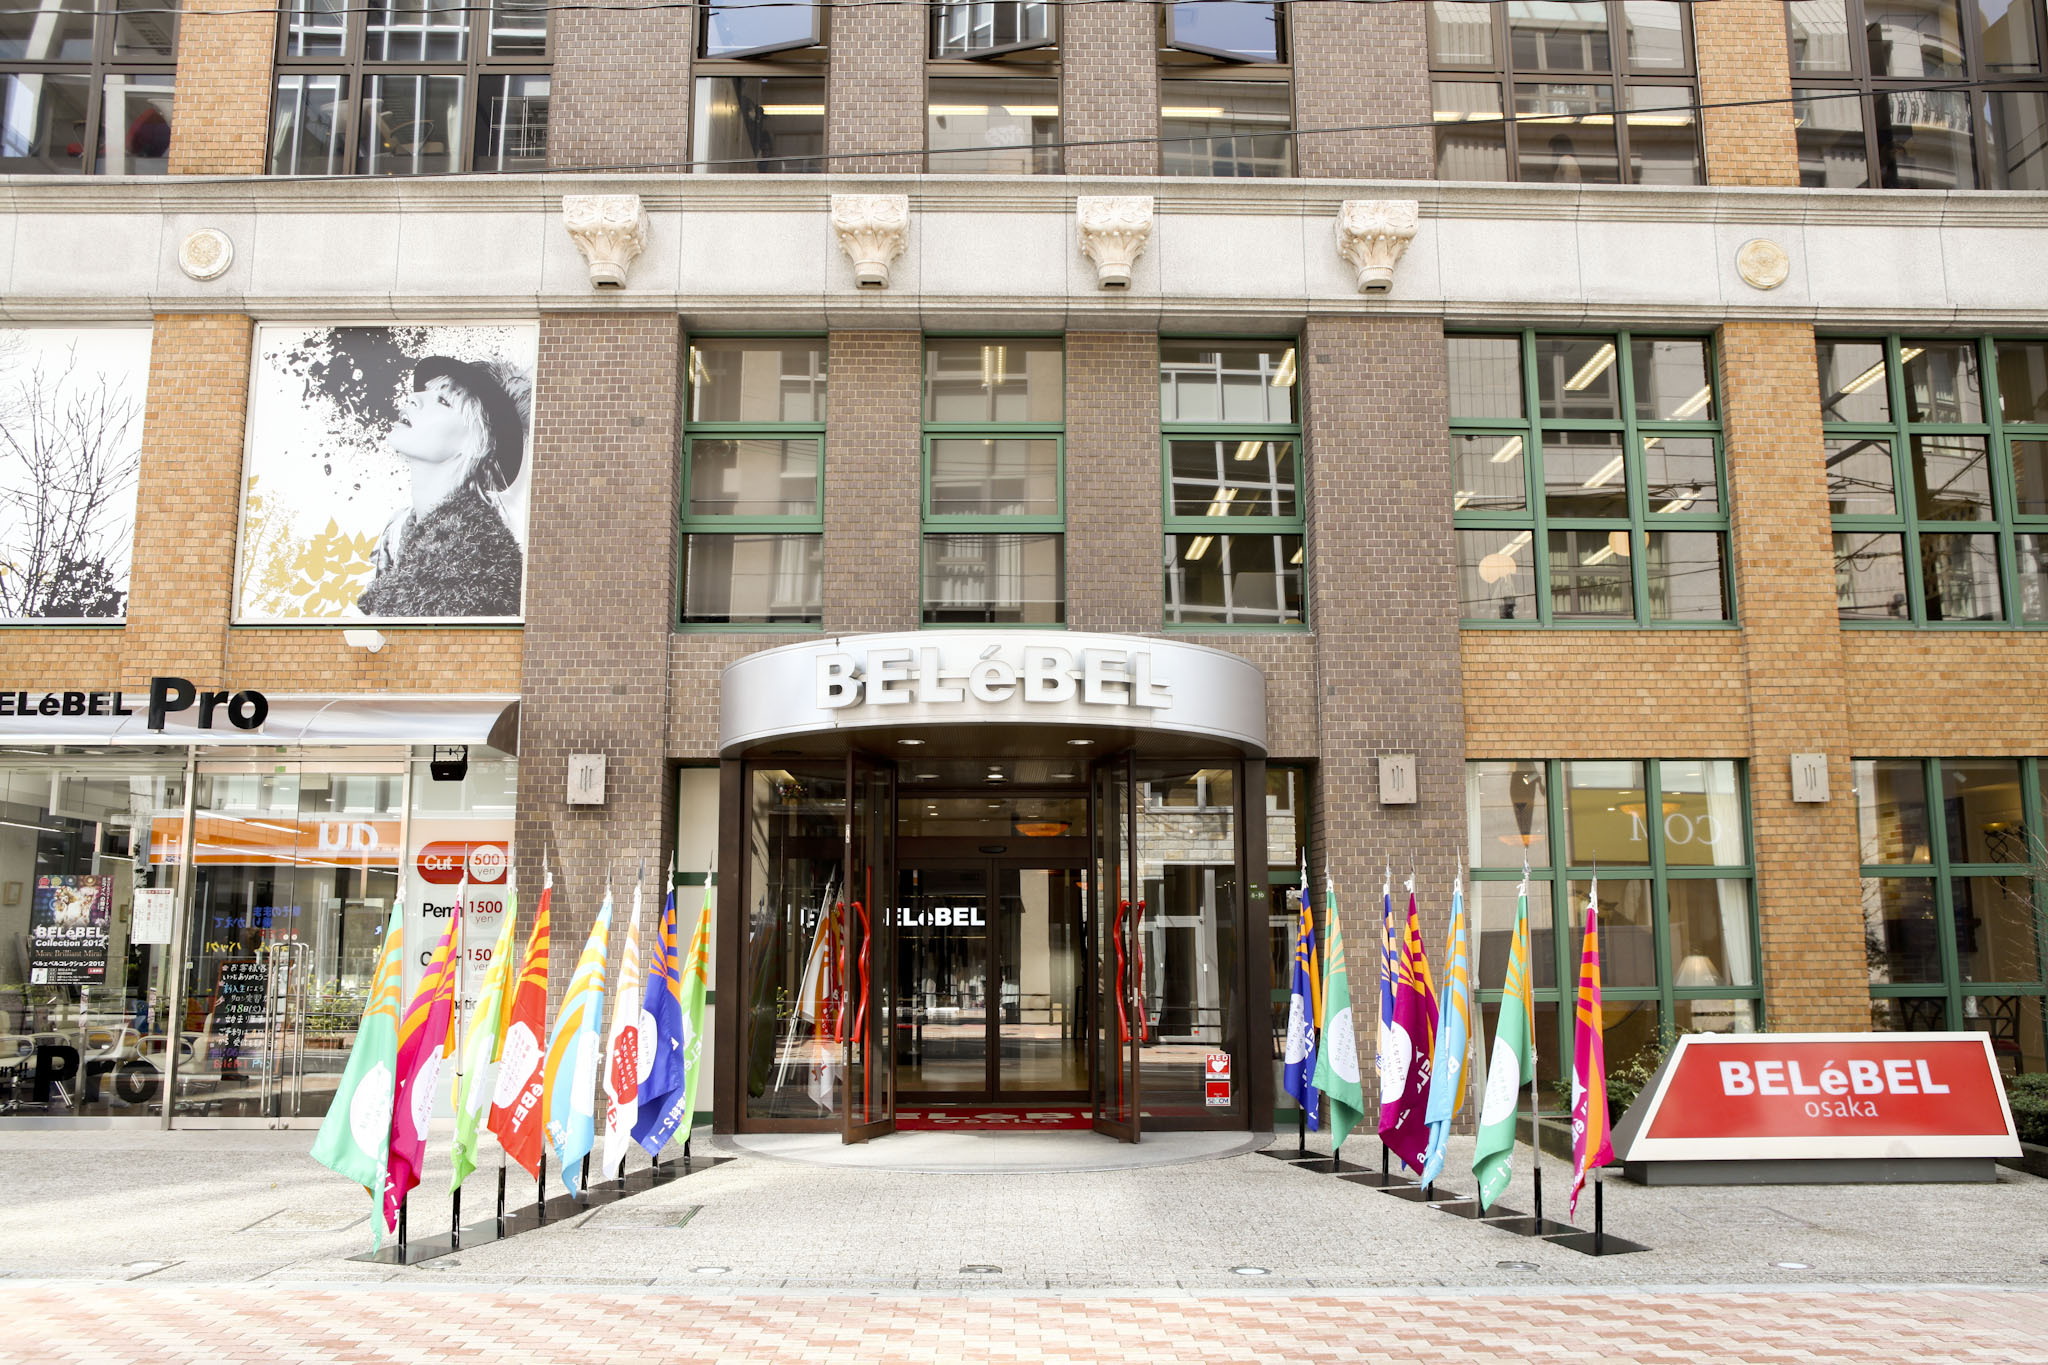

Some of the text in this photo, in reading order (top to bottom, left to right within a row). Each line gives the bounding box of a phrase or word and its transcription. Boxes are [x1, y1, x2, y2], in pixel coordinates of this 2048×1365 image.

[815, 645, 1174, 710] BELéBEL
[0, 676, 269, 730] ELéBEL Pro
[424, 853, 500, 871] Cut 500
[477, 867, 495, 876] yen
[469, 900, 503, 914] 1500
[475, 914, 494, 924] yen
[36, 926, 105, 939] BELéBEL
[33, 1046, 159, 1104] Pro
[1719, 1059, 1951, 1096] BELéBEL
[1804, 1095, 1879, 1118] osaka
